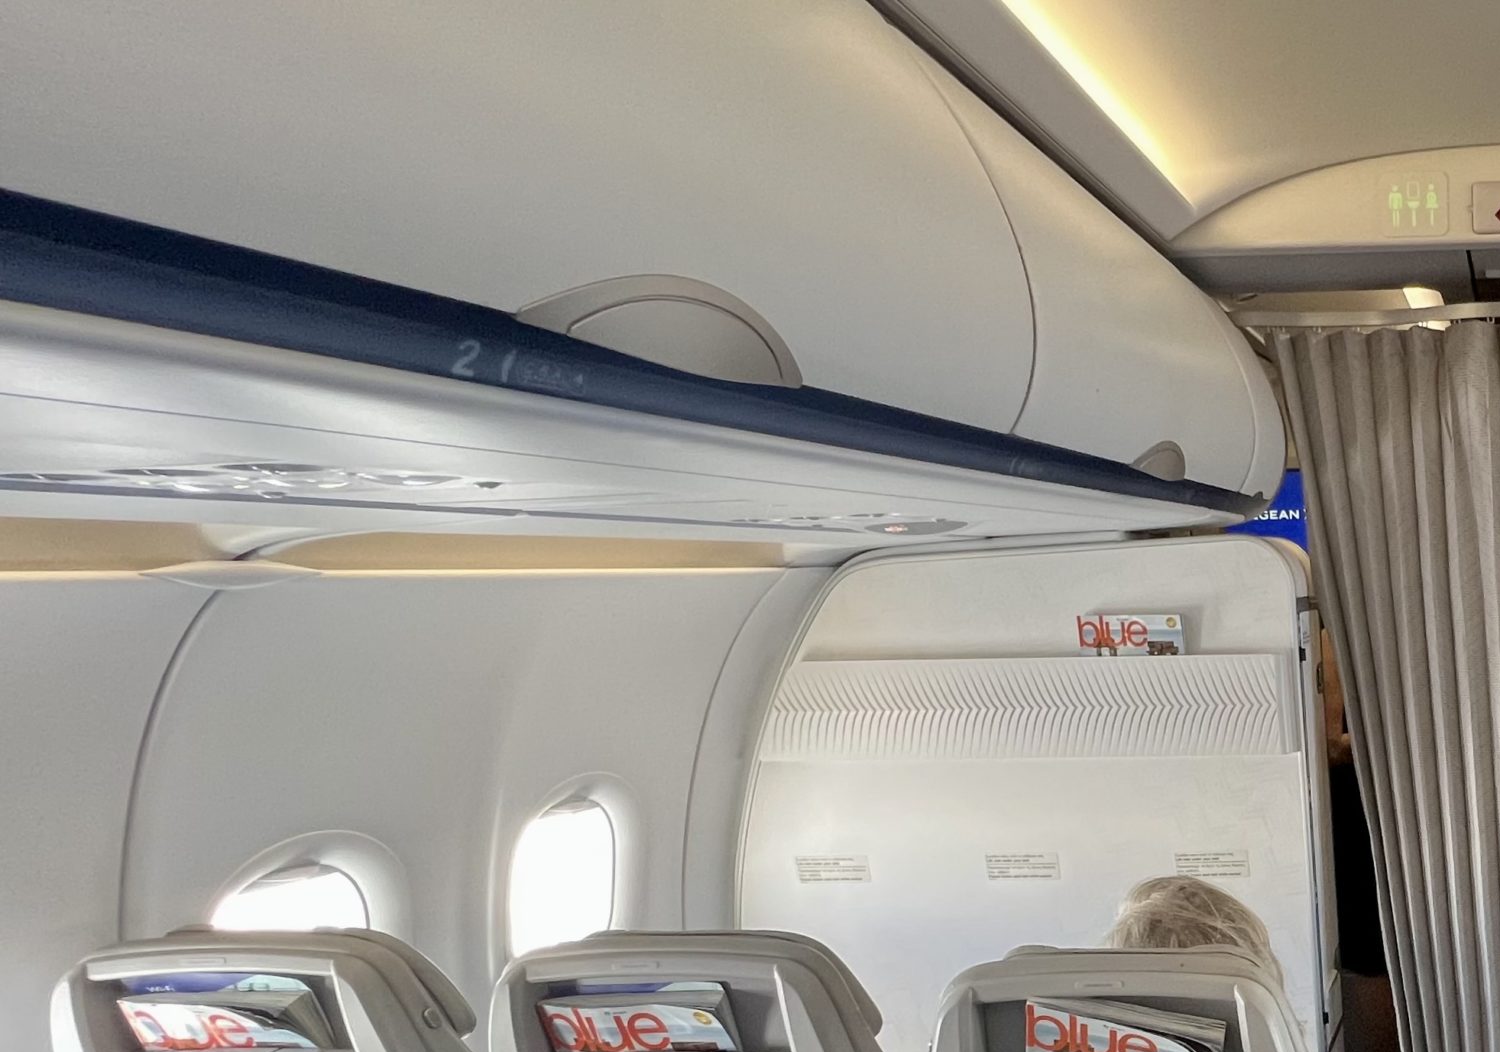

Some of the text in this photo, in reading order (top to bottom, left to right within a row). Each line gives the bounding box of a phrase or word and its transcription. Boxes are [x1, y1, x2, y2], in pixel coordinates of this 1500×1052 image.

[452, 339, 481, 377] 2
[1253, 509, 1300, 521] GEAN
[1076, 615, 1148, 648] blue
